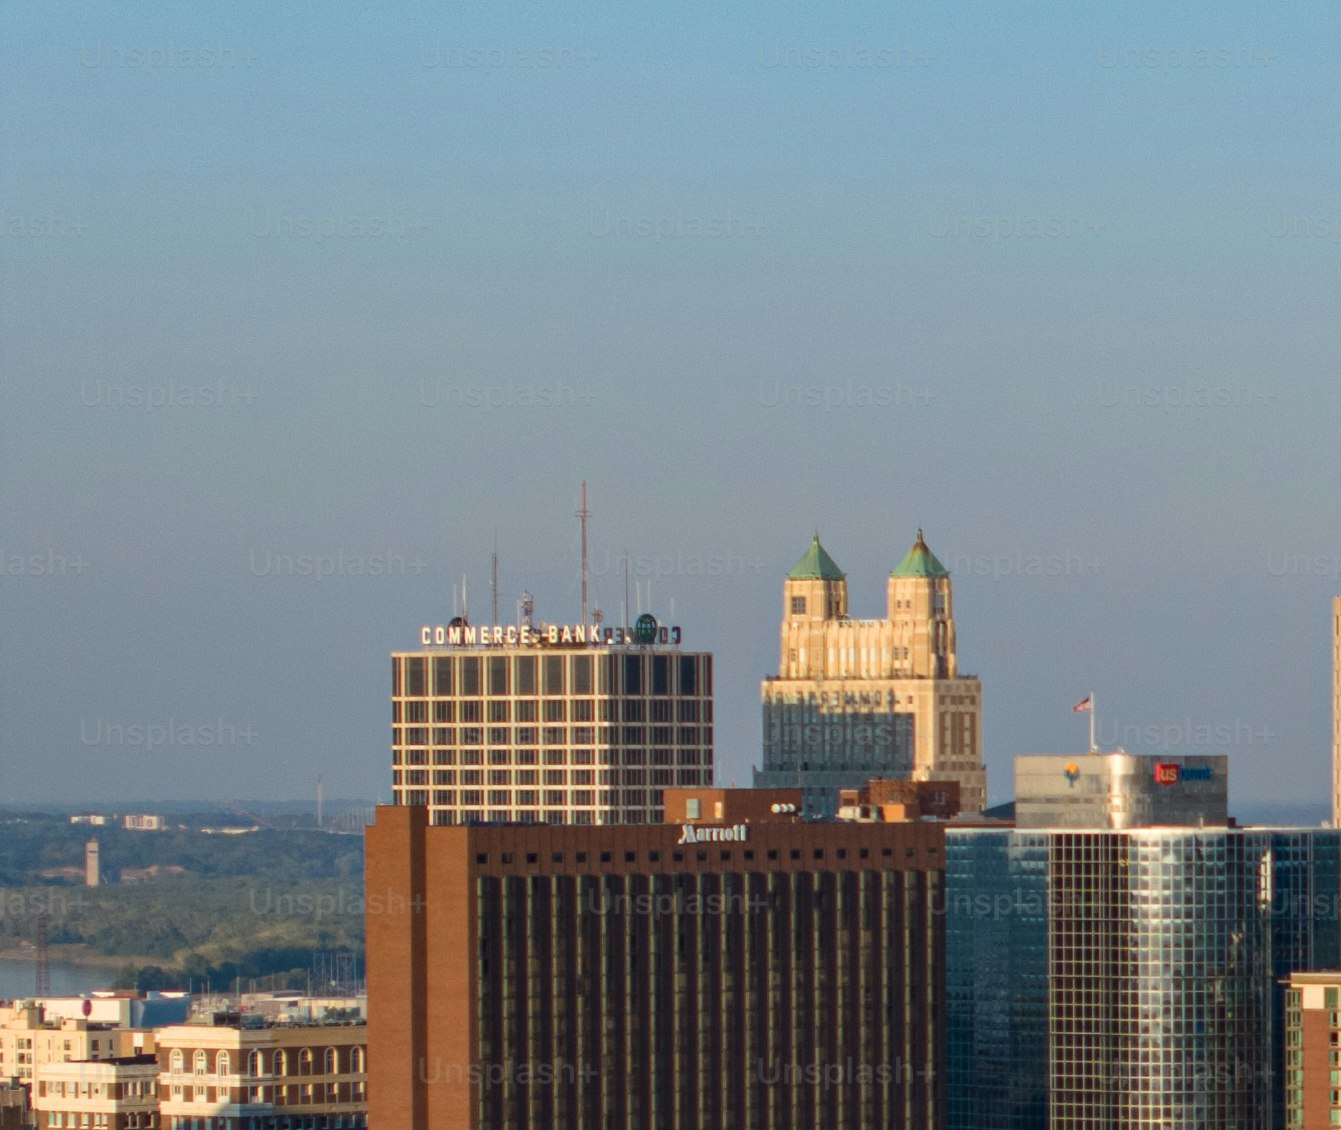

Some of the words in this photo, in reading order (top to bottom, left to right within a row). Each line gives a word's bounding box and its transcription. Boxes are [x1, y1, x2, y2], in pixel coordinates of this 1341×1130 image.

[421, 625, 530, 645] COMMERCE
[548, 624, 600, 644] BANK
[677, 823, 747, 844] Marriott
